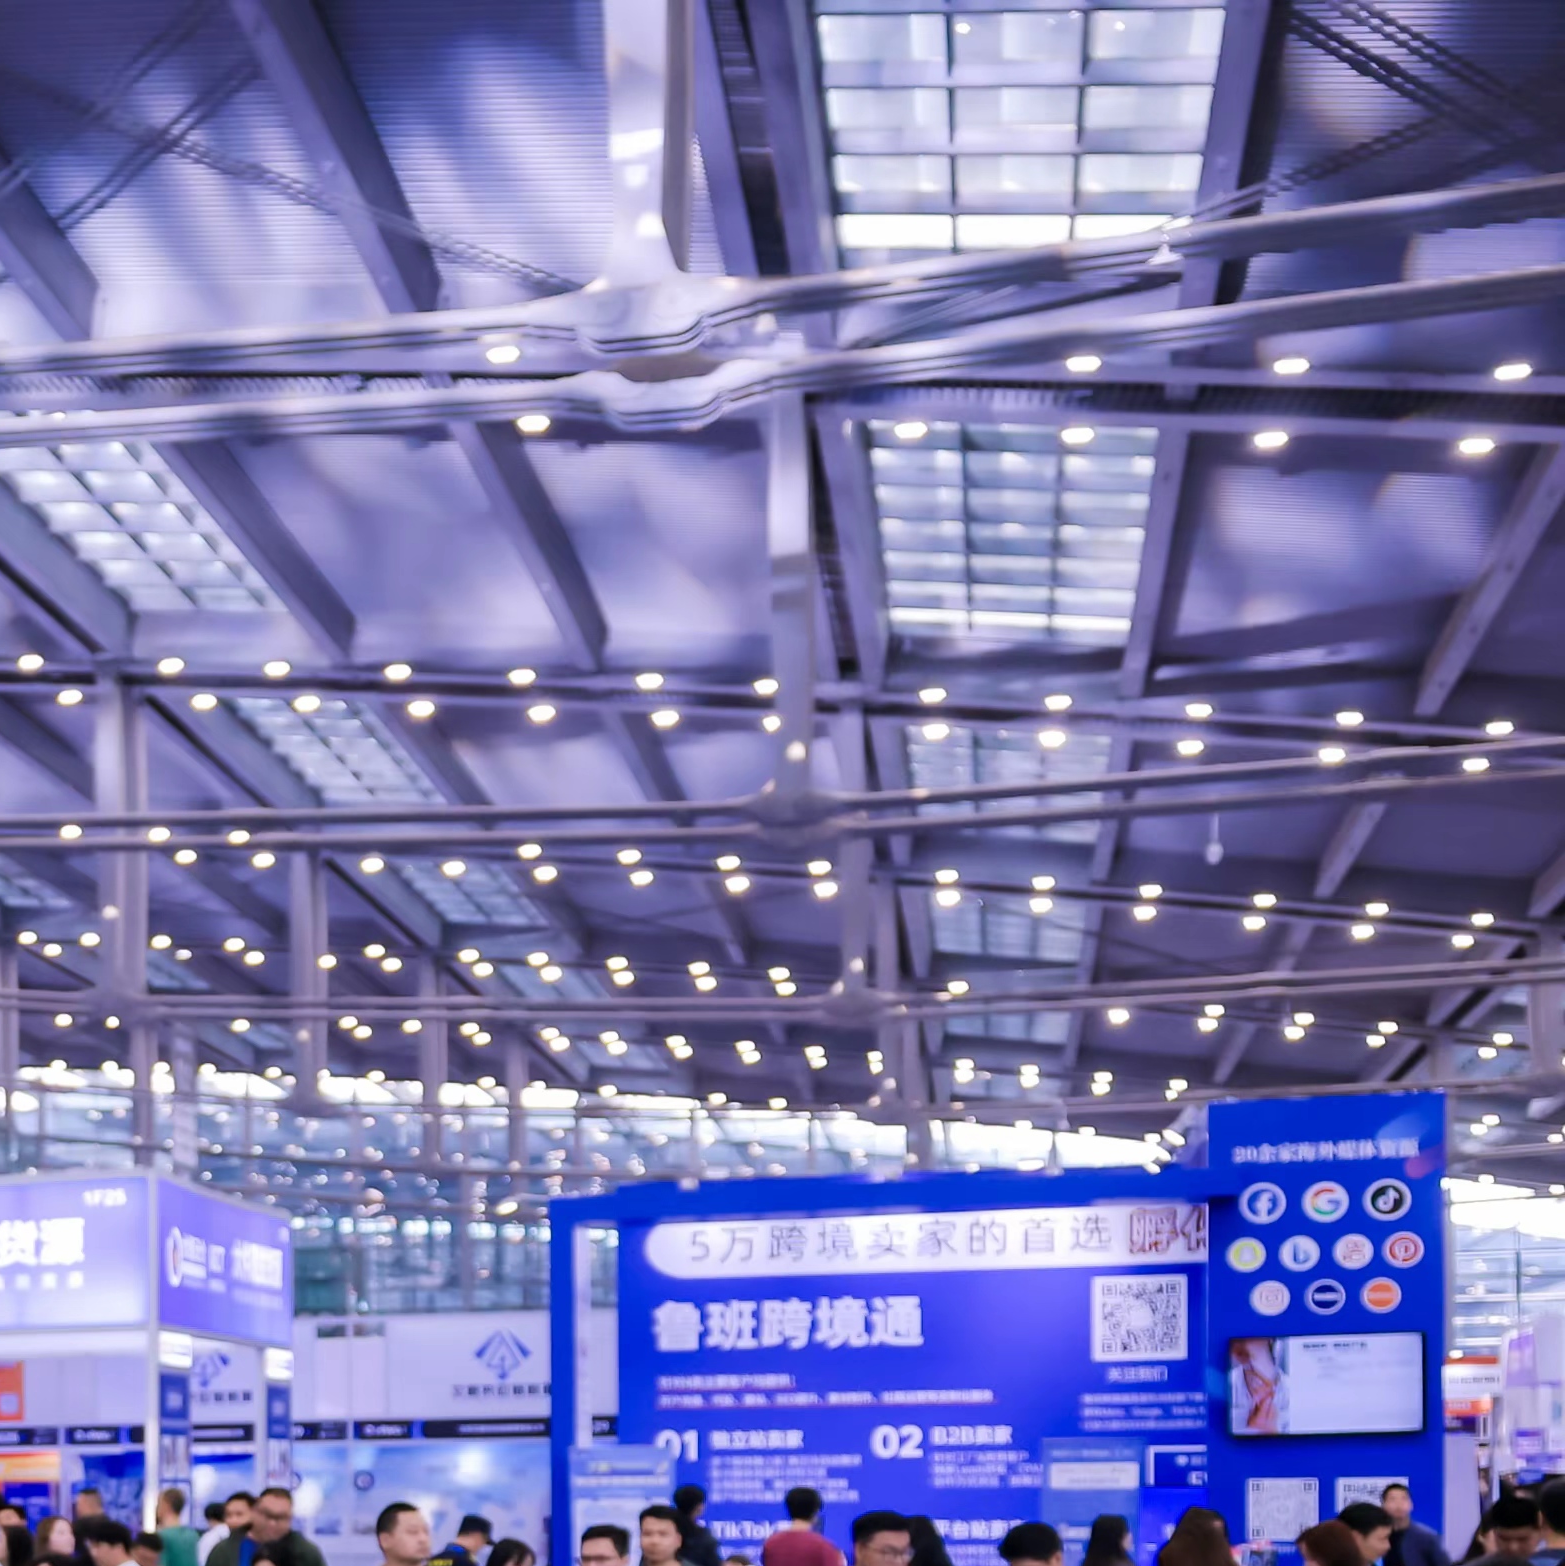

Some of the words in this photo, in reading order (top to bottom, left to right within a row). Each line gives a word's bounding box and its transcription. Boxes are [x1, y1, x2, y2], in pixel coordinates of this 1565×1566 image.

[690, 1213, 1112, 1263] 5万跨境卖家的首选
[652, 1295, 925, 1352] 鲁班跨境通
[654, 1429, 699, 1462] 01
[870, 1424, 925, 1460] 02
